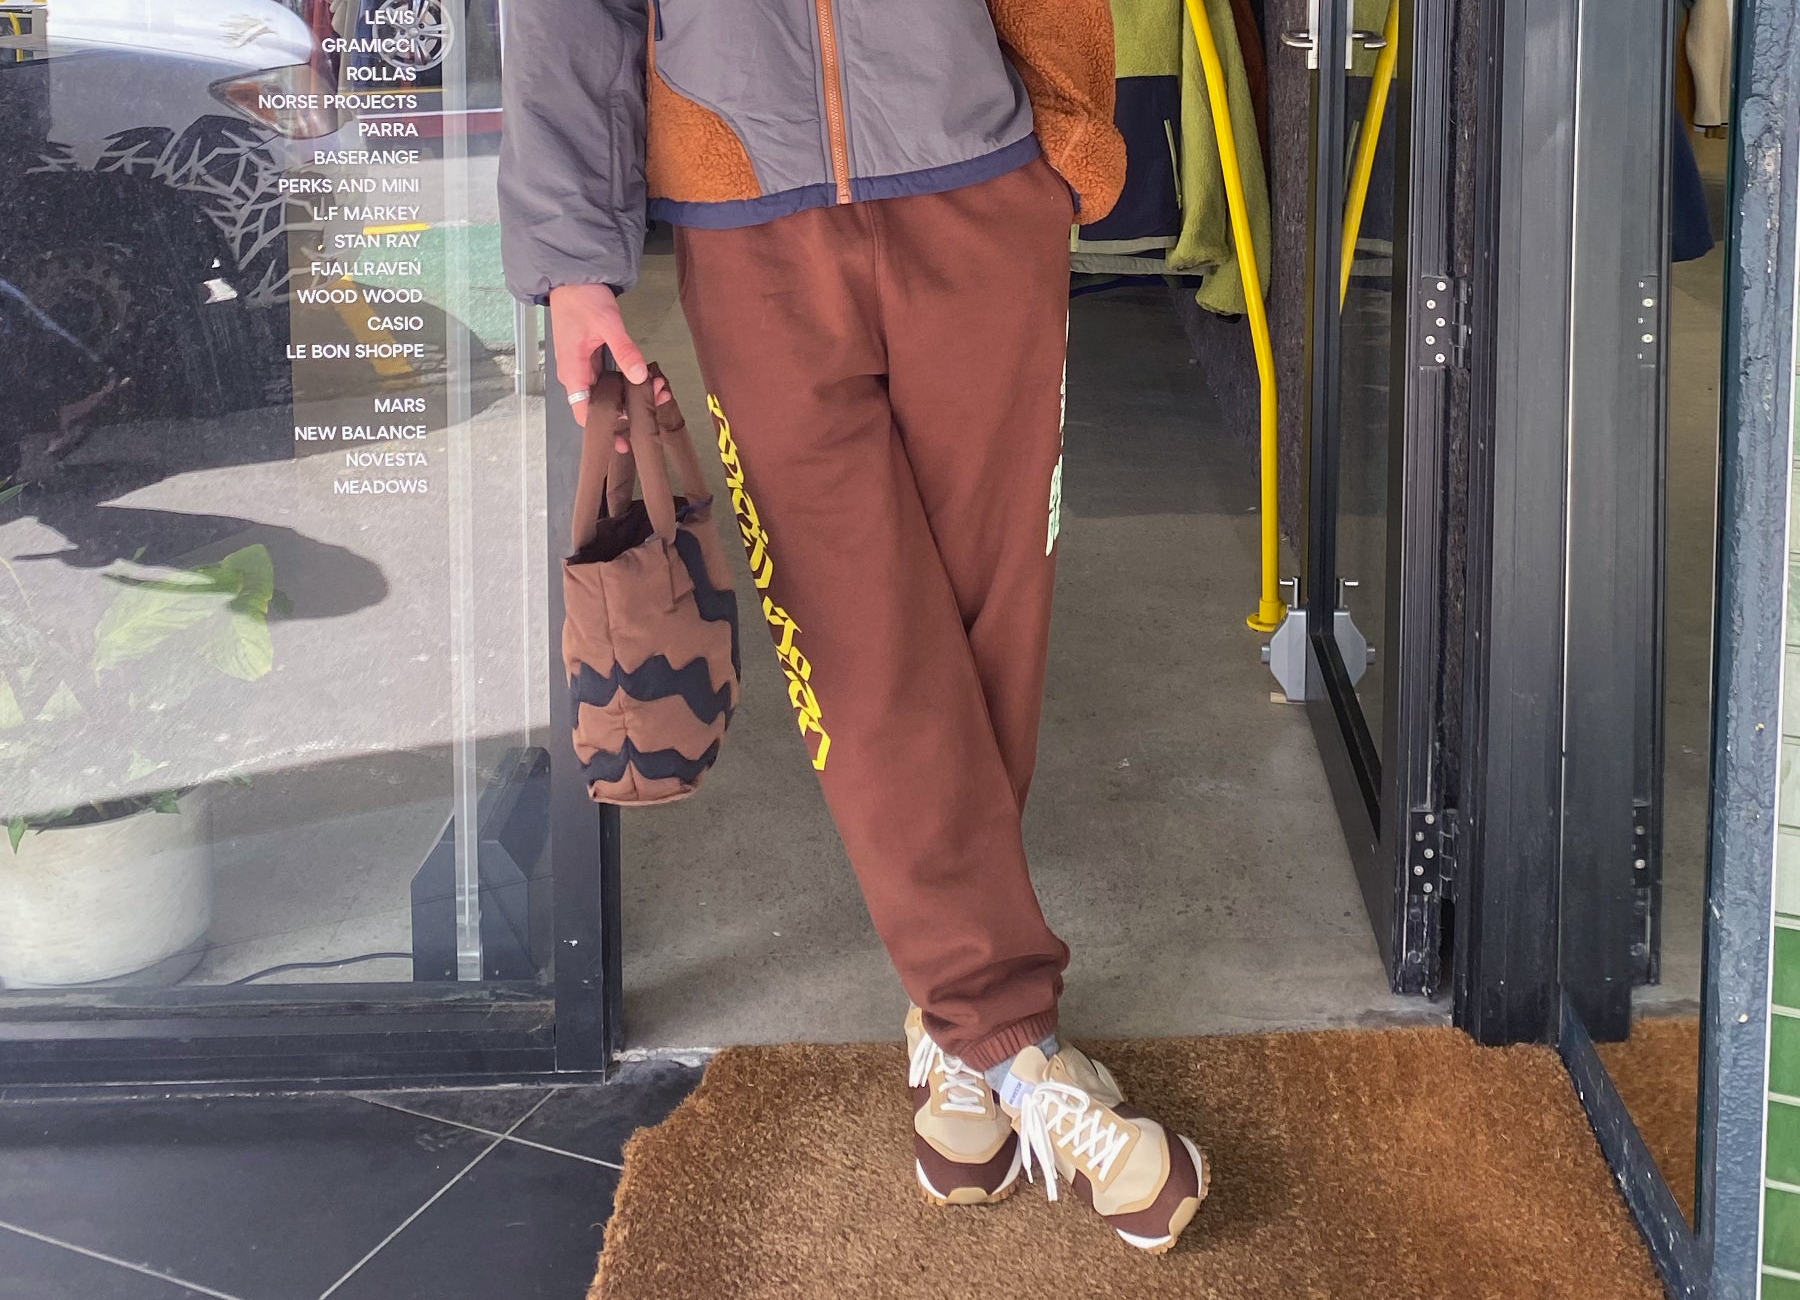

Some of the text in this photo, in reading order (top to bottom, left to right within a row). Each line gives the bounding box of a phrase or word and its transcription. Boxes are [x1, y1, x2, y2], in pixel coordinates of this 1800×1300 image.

[365, 9, 415, 25] LEVIS
[322, 37, 415, 53] GRAMICCI
[346, 66, 417, 82] ROLLAS
[258, 95, 418, 110] NORSE PROJECTS
[358, 122, 419, 137] PARRA
[314, 150, 420, 165] BASERANGE
[278, 178, 420, 194] PERKS AND MINI
[313, 206, 420, 222] L.F MARKEY
[334, 234, 421, 249] STAN RAY
[311, 261, 422, 277] FJALLRAVEN
[297, 289, 423, 304] WOOD WOOD
[367, 316, 424, 331] CASIO
[286, 343, 424, 359] LE BON SHOPPE
[374, 397, 426, 413] MARS
[294, 425, 426, 441] NEW BALANCE
[346, 452, 427, 467] NOVESTA
[333, 479, 428, 494] MEADOWS
